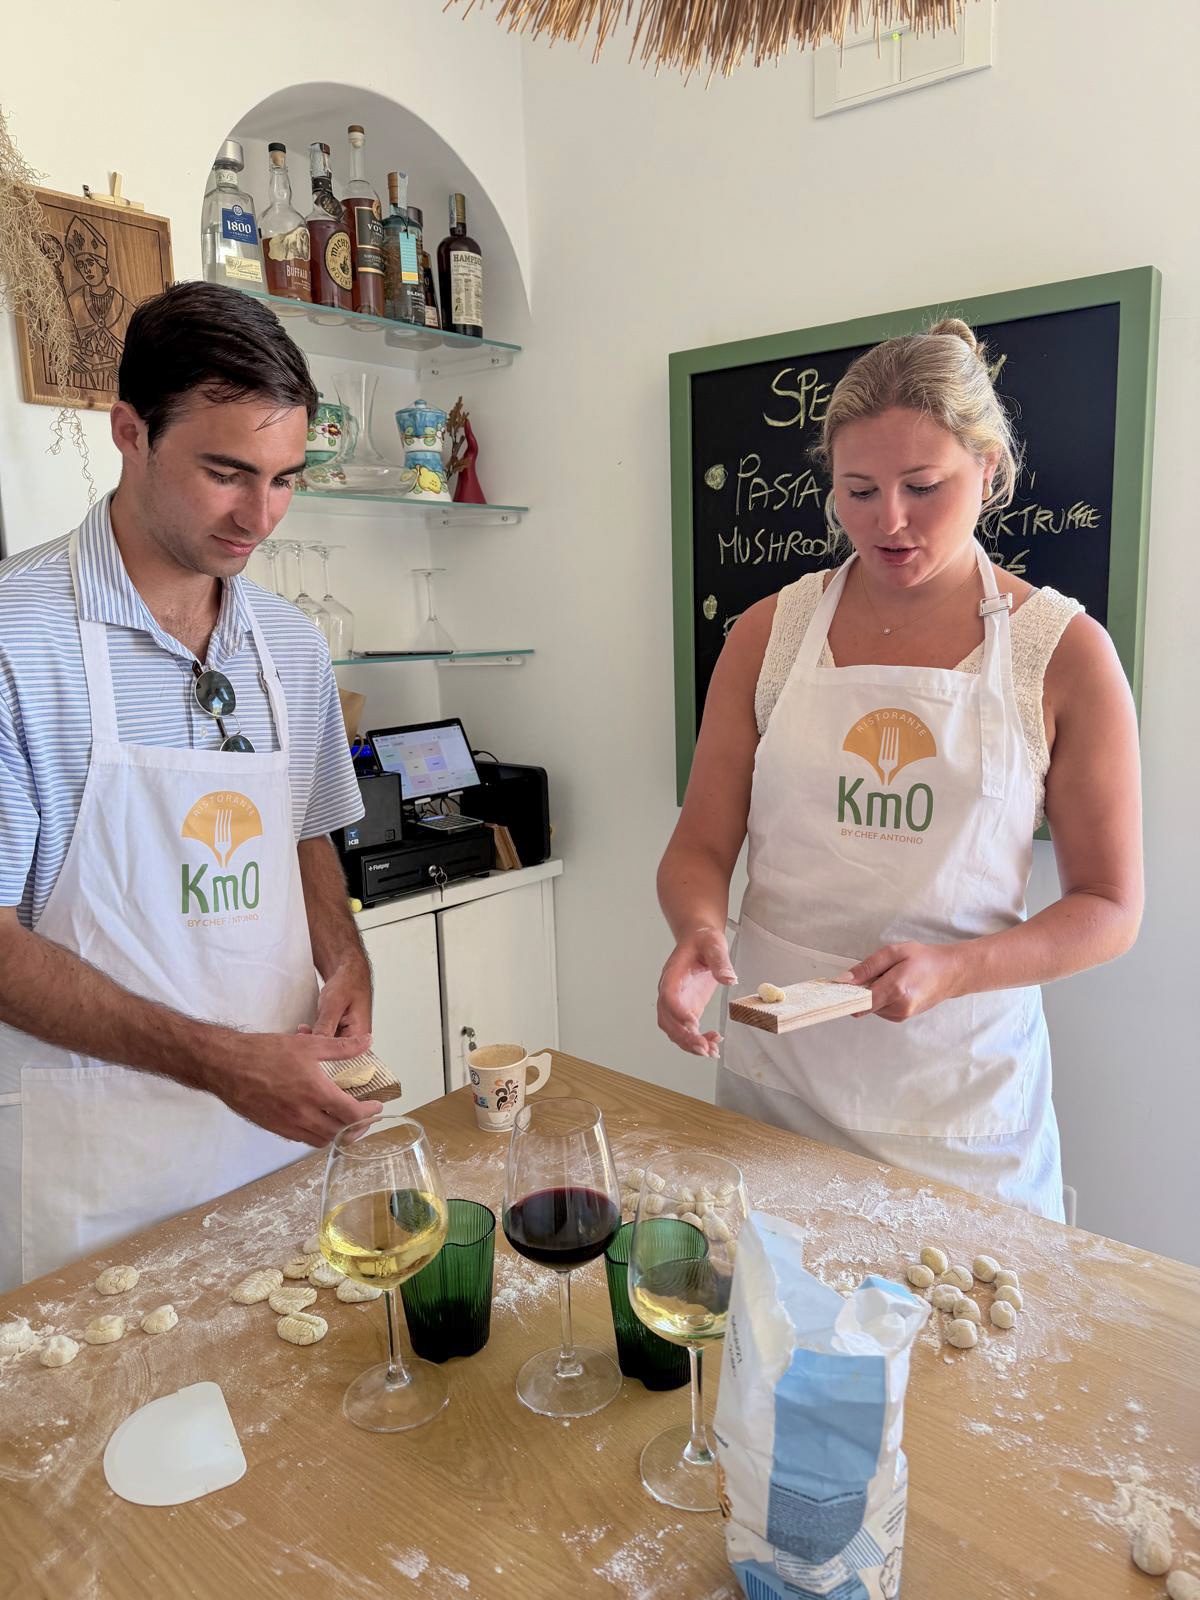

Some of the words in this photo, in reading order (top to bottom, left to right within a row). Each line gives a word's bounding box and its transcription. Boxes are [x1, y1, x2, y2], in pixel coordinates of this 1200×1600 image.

[227, 220, 251, 234] 1800
[764, 367, 831, 429] SPE
[736, 453, 823, 516] PASTA
[856, 711, 927, 737] RISTORANTE
[840, 828, 852, 836] BY
[854, 830, 879, 840] CHEF
[880, 833, 923, 845] ANTONIO
[187, 918, 200, 928] BY
[202, 917, 225, 927] CHEF
